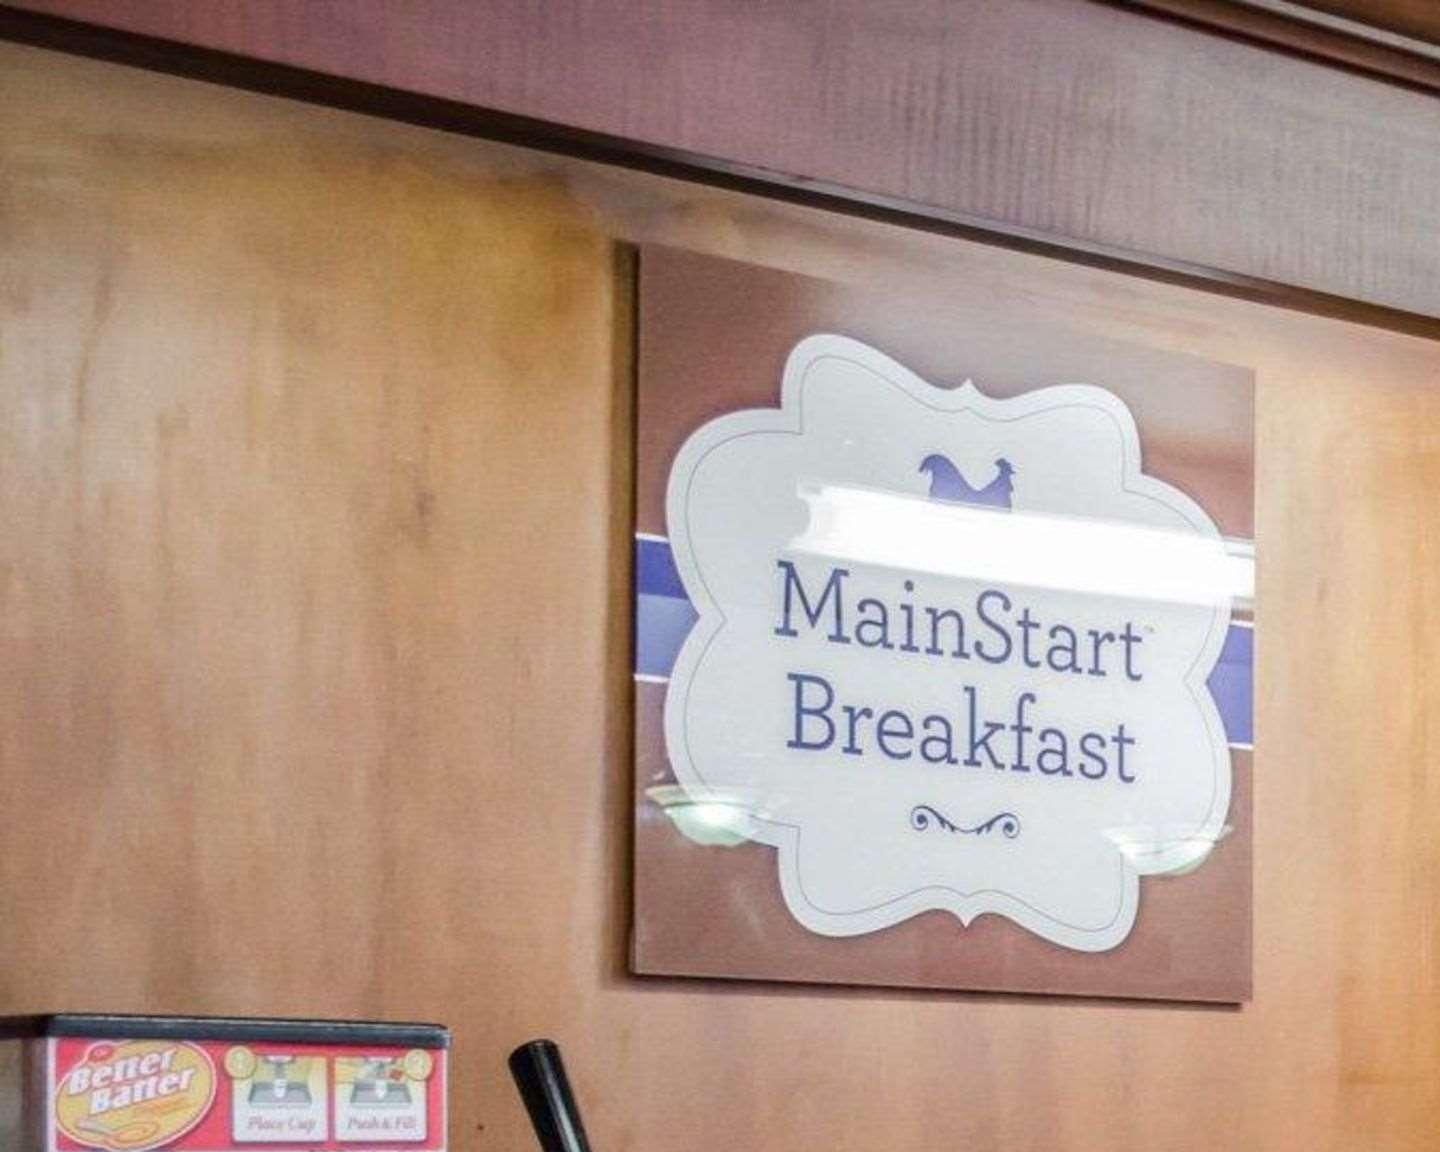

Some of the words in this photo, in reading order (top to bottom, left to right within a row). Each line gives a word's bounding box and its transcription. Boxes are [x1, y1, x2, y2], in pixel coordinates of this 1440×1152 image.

[774, 561, 1145, 682] MainStart
[786, 673, 1137, 783] Breakfast
[68, 1050, 177, 1095] Better
[89, 1067, 195, 1114] Batter
